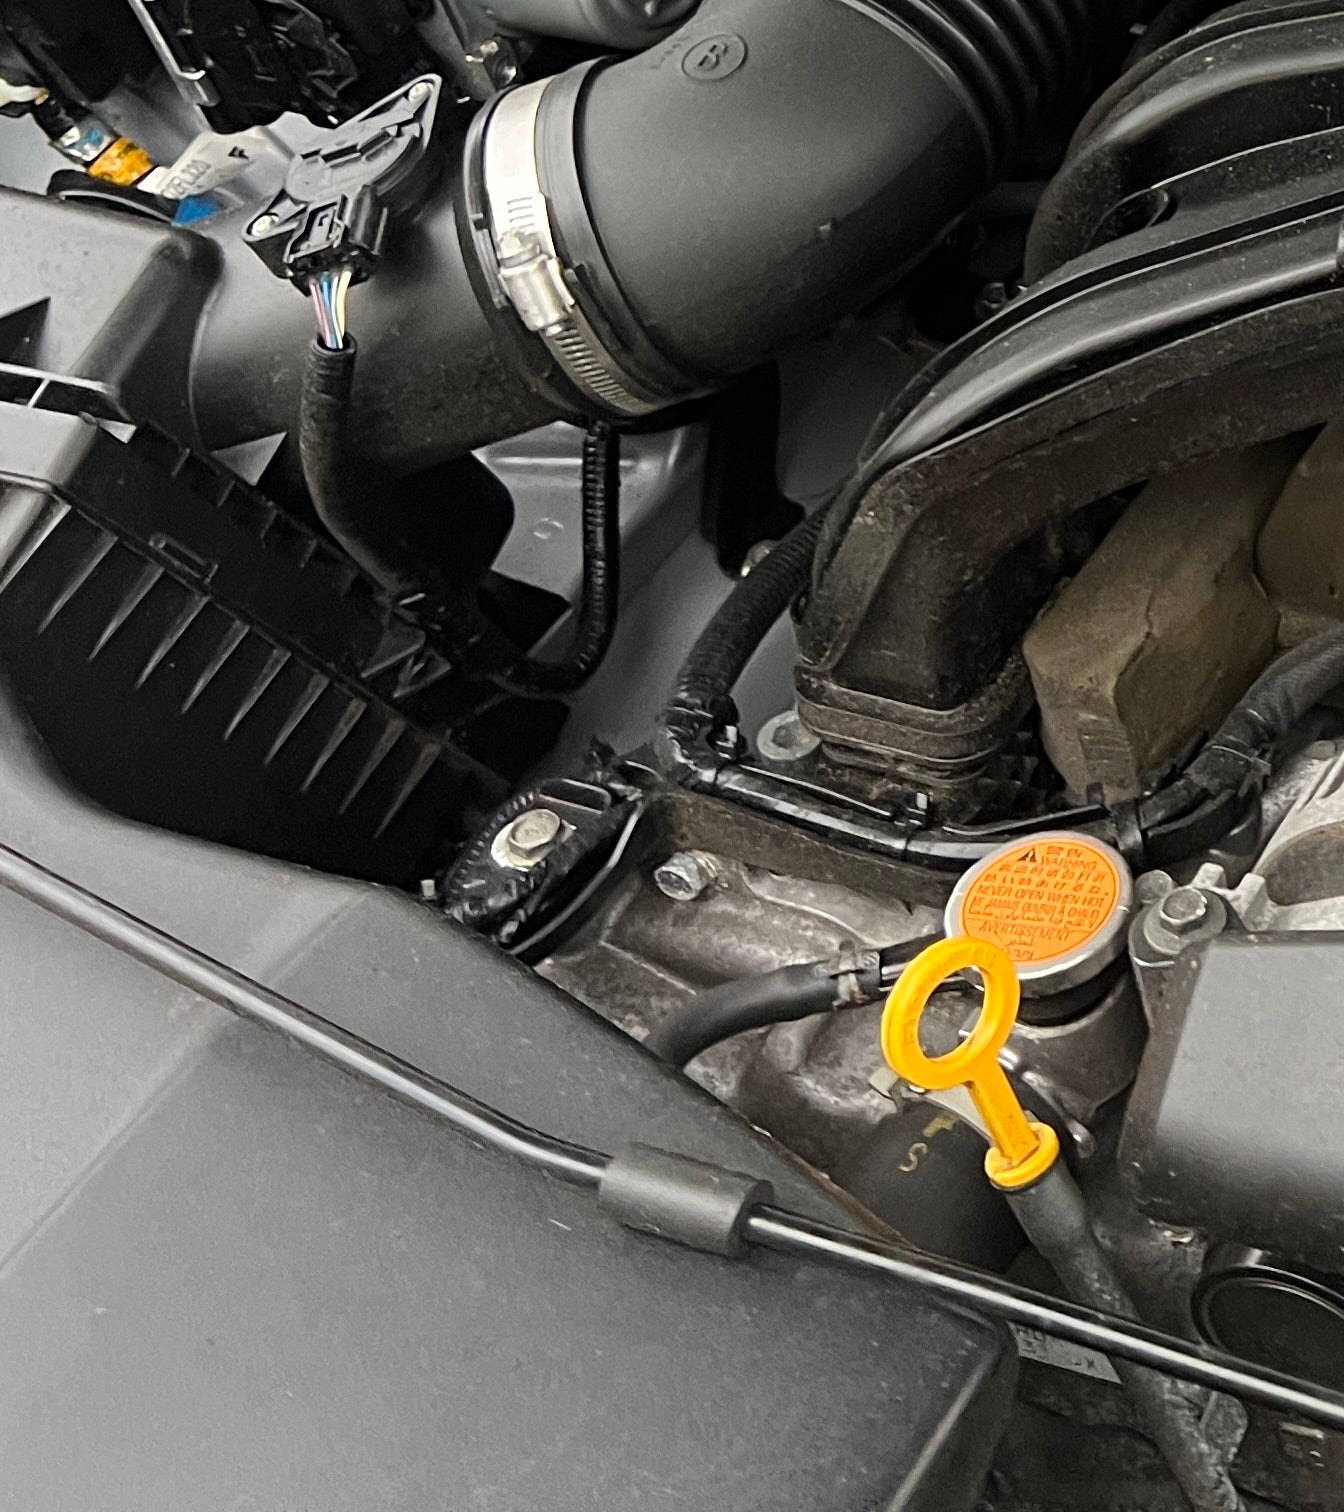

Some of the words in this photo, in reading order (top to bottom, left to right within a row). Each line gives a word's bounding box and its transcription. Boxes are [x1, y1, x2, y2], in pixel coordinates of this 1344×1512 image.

[1015, 888, 1045, 900] OPEN
[1048, 892, 1079, 905] WHEN
[1082, 896, 1105, 907] HOT
